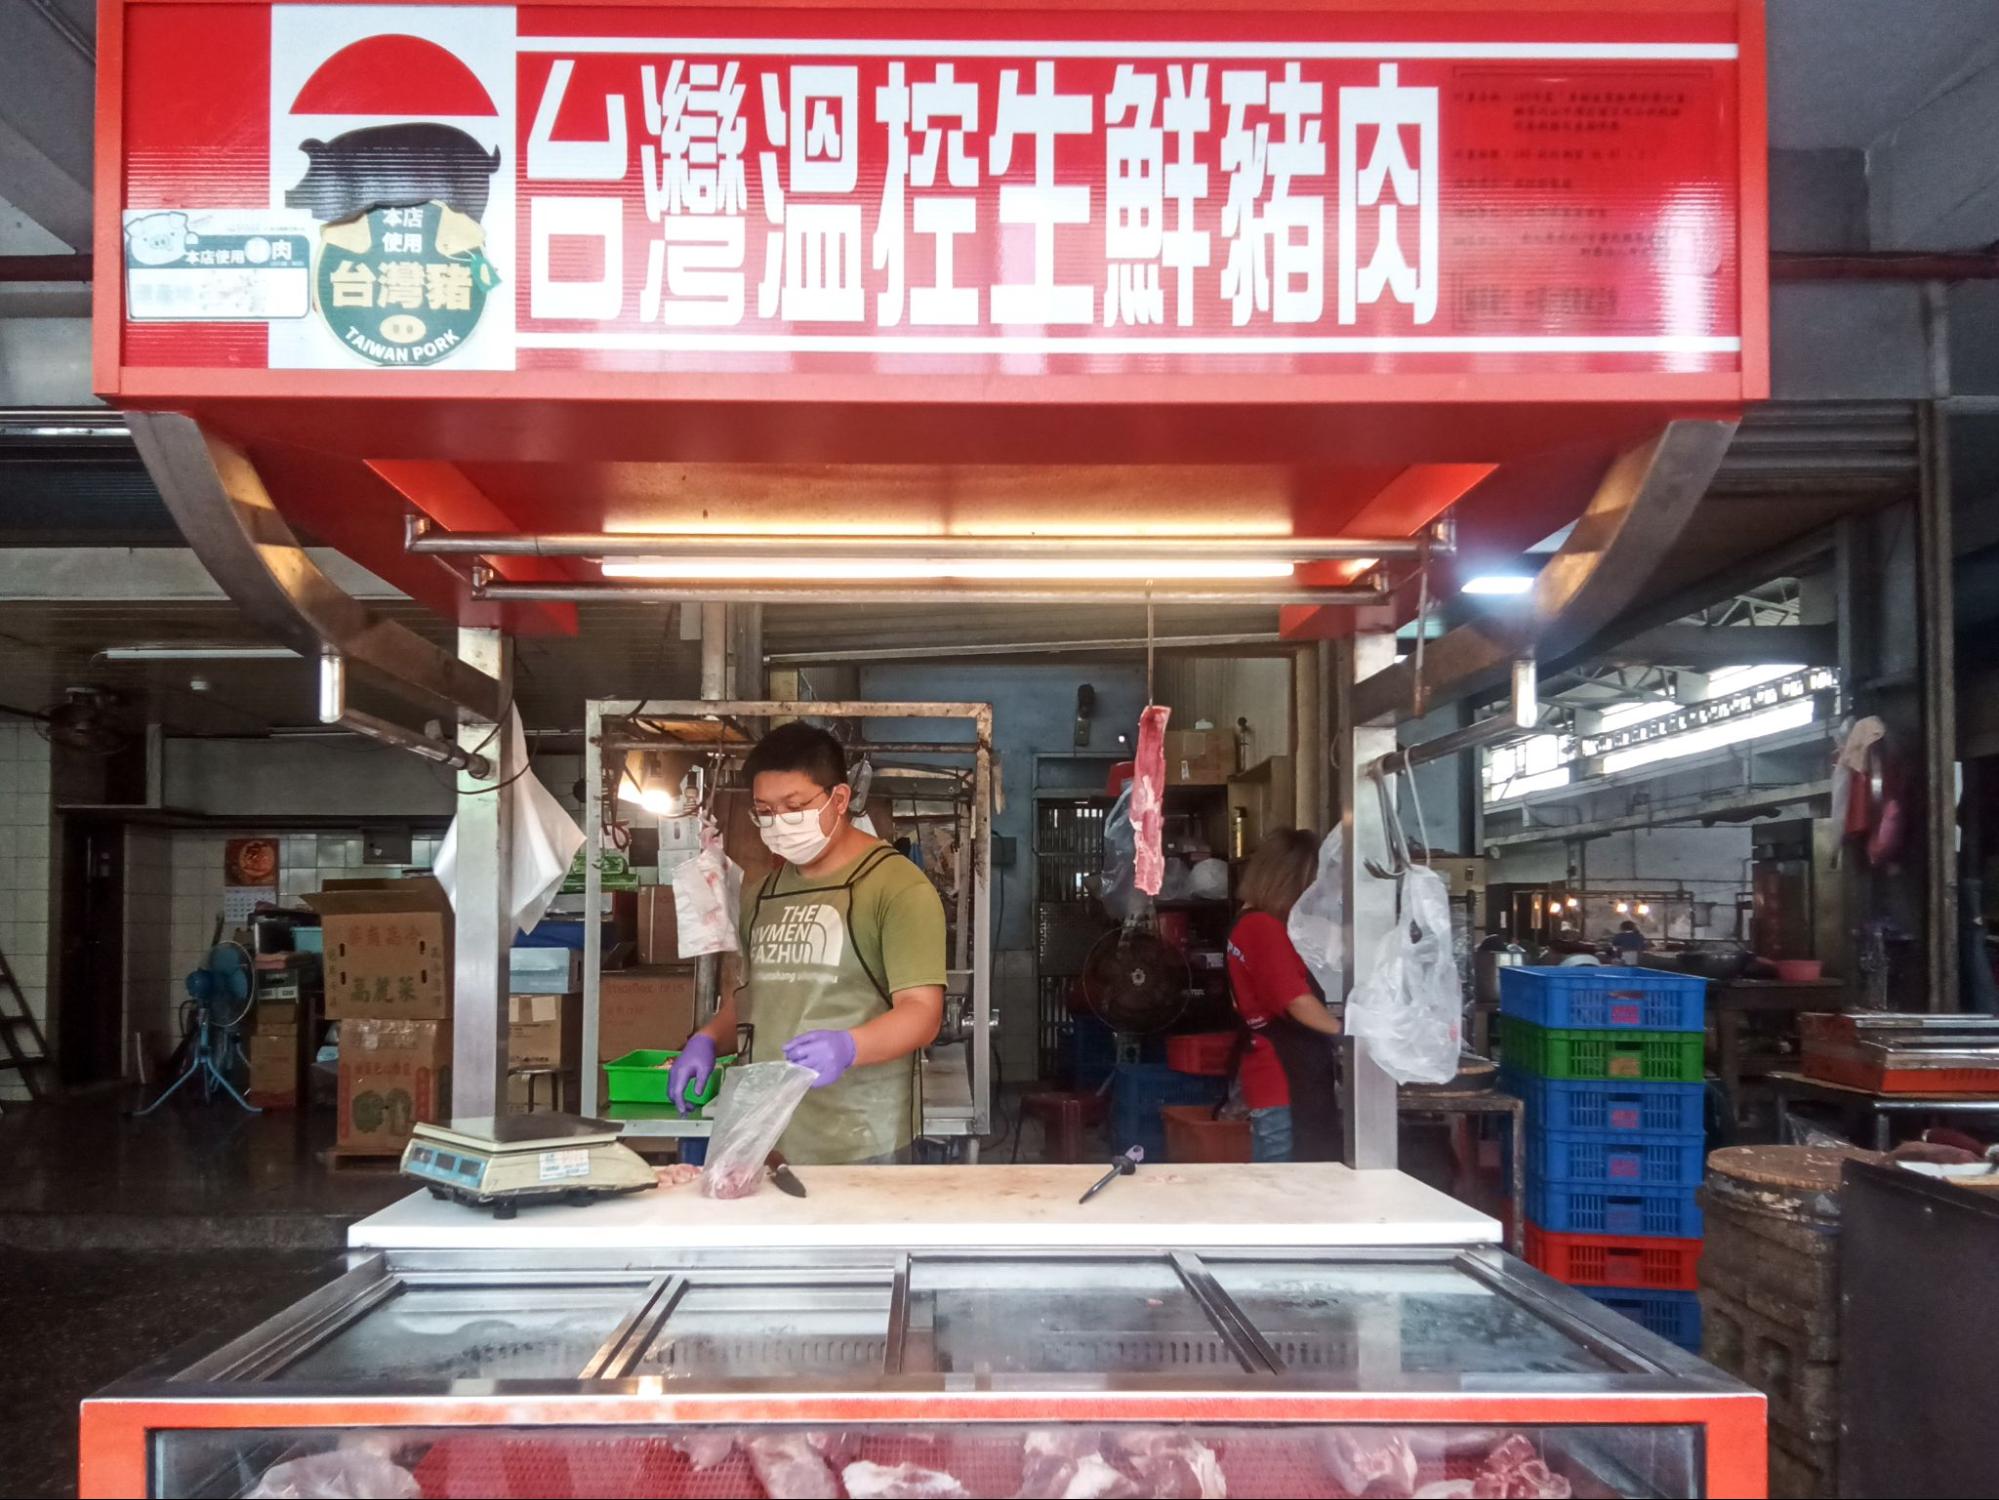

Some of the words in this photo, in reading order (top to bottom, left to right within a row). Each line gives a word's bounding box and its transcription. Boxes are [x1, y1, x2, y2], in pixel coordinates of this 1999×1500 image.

[526, 59, 1440, 327] 台灣溫控生鮮豬肉
[382, 207, 424, 229] 本店
[381, 232, 423, 253] 使用
[330, 260, 473, 310] 台灣豬
[344, 326, 408, 362] TAIWAN
[414, 329, 461, 361] PORK
[782, 905, 816, 923] THE
